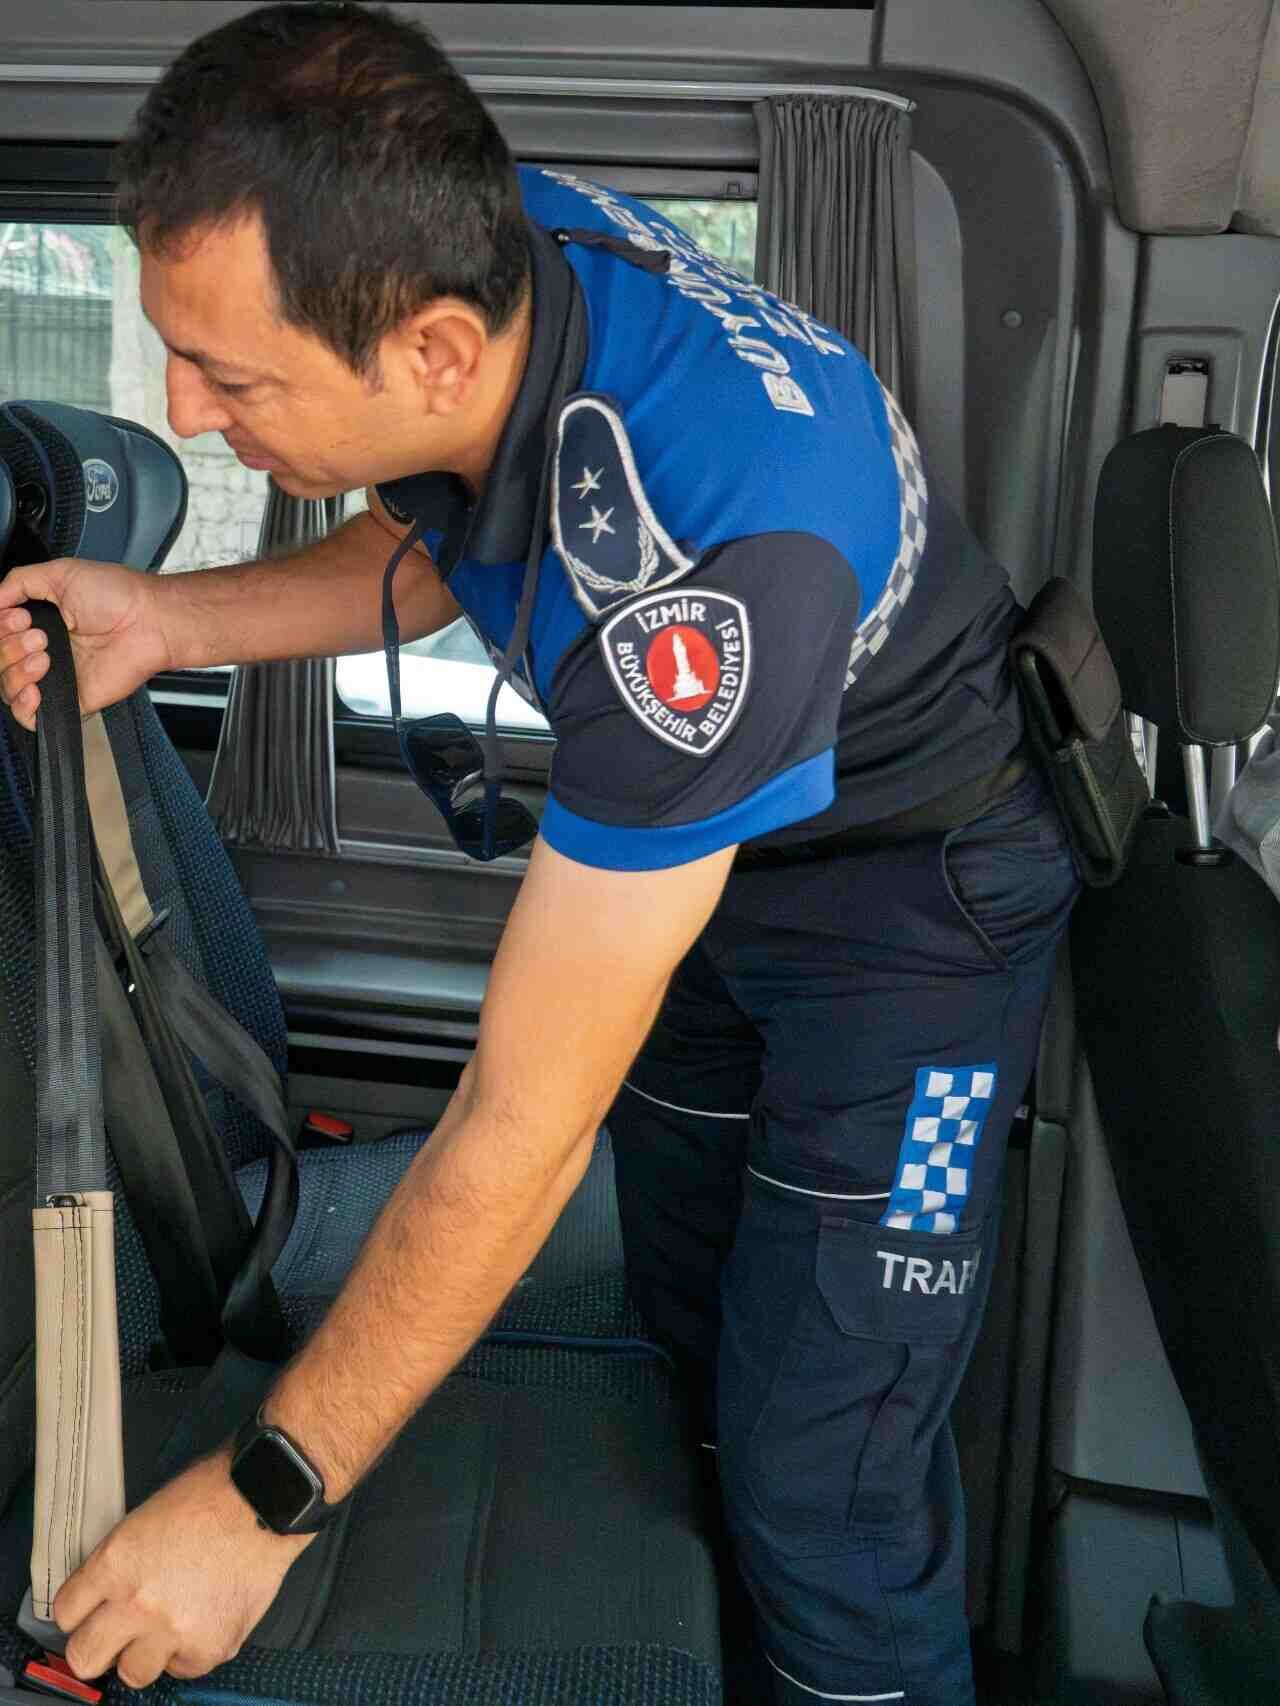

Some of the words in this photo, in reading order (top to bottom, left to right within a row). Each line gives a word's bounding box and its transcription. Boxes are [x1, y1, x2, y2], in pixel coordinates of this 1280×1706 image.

[87, 468, 112, 502] Ford
[635, 599, 707, 633] İZMİR
[617, 641, 697, 743] BÜYÜKŞEHİR
[698, 618, 741, 737] BELEDİYESİ
